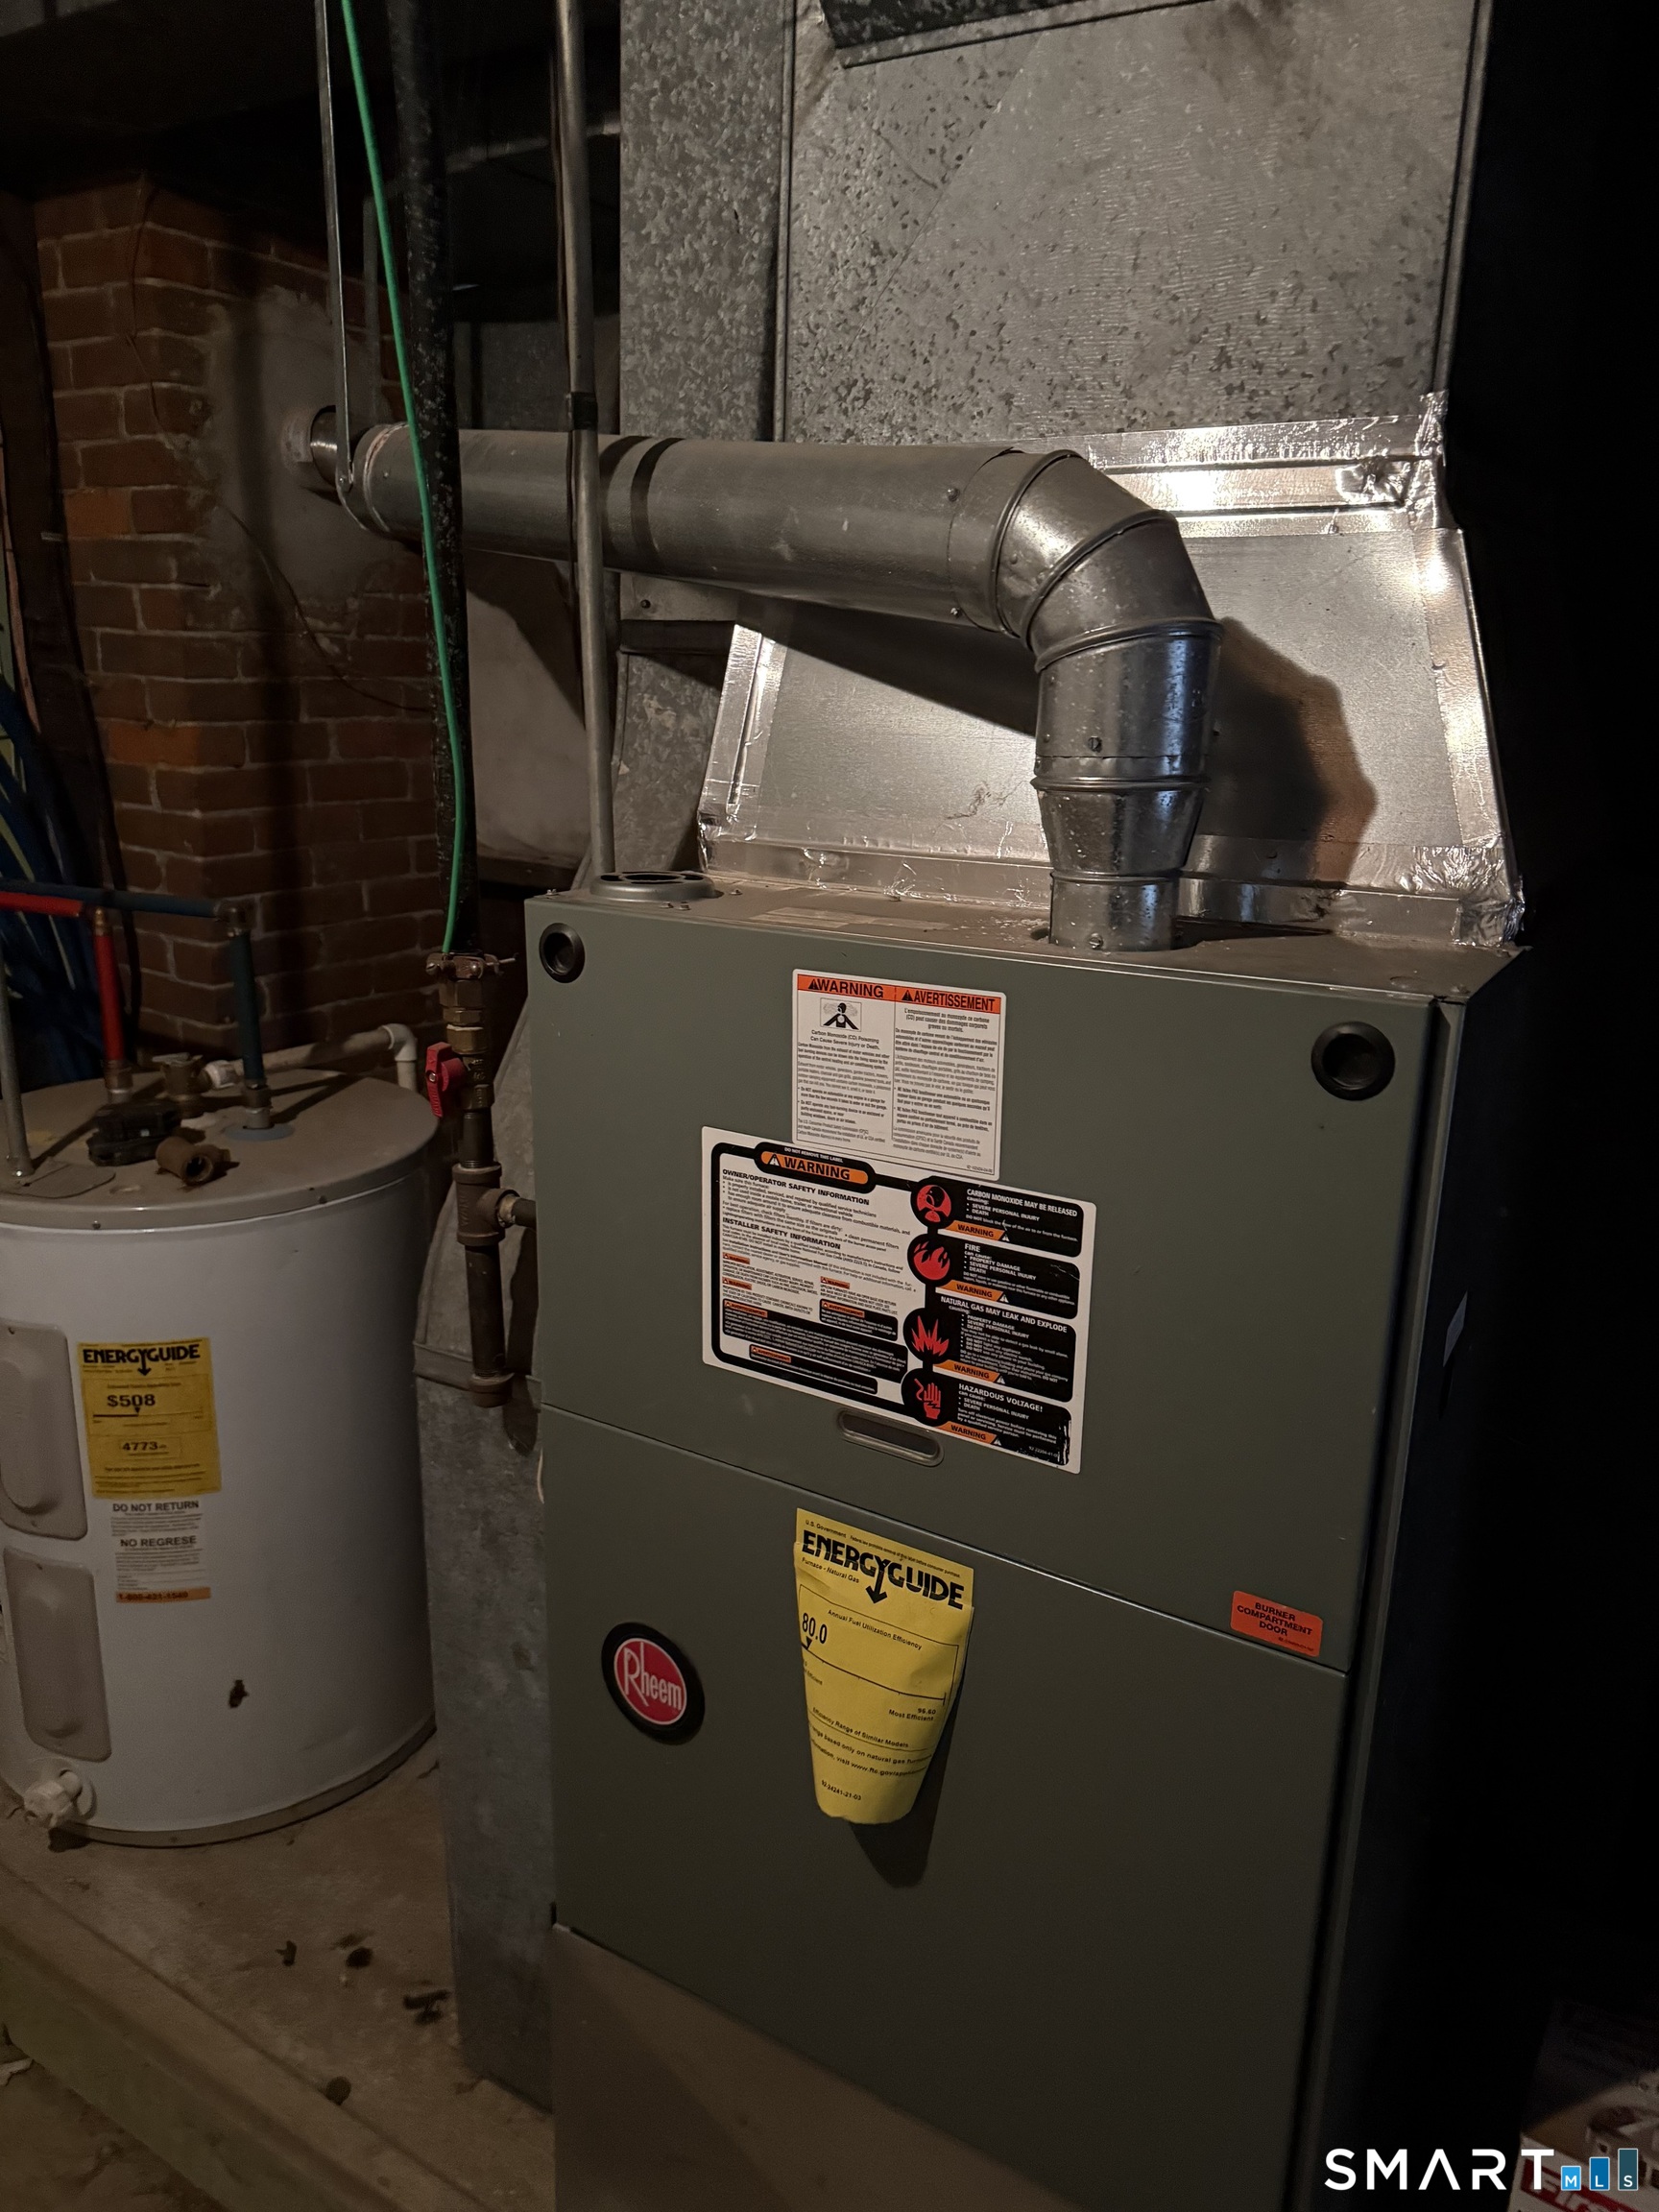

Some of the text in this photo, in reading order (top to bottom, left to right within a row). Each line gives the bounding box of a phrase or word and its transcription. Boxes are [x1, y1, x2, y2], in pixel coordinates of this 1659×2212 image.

[818, 979, 883, 998] WARNING
[914, 990, 995, 1011] AVERTISSEMENT
[784, 1157, 850, 1180] WARNING
[723, 1169, 869, 1205] OWNER/OPERATOR SAFETY INFORMATION
[967, 1189, 990, 1199] CARBON
[992, 1193, 1023, 1206] MONOXIDE
[1024, 1200, 1038, 1209] MAY
[1047, 1205, 1077, 1216] RELEASED
[972, 1203, 991, 1212] SEVERE
[993, 1208, 1020, 1217] PERSONAL
[723, 1216, 841, 1250] INSTALLER SAFETY INFORMATION
[958, 1224, 994, 1237] WARNING
[965, 1243, 980, 1252] FIRE
[970, 1257, 1021, 1271] PROPERTY DAMAGE
[989, 1266, 1017, 1276] PERSONAL
[956, 1284, 992, 1297] WARNING
[941, 1296, 970, 1309] NATURAL
[986, 1308, 1001, 1316] MAY
[1002, 1311, 1019, 1321] LEAK
[1021, 1316, 1035, 1325] AND
[1038, 1320, 1068, 1333] EXPLODE
[967, 1315, 1015, 1330] PROPERTY DAMAGE
[986, 1324, 1011, 1334] PERSONAL
[83, 1344, 201, 1366] ENERGYGUIDE
[954, 1364, 989, 1379] WARNING
[107, 1394, 156, 1407] $508
[959, 1383, 1043, 1412] HAZARDOUS VOLTAGE!
[969, 1393, 986, 1402] cause:
[964, 1398, 1029, 1420] SEVERE PERSONAL INJURY
[951, 1425, 986, 1440] WARNING
[122, 1441, 158, 1451] 4773
[112, 1501, 199, 1512] DO NOT RETURN
[816, 1524, 846, 1538] Government
[141, 1535, 196, 1547] REGRESE
[801, 1529, 965, 1611] ENERGYGUIDE
[803, 1557, 822, 1570] Furnace
[827, 1567, 847, 1578] Natural
[1237, 1605, 1312, 1635] COMPARTMENT
[1255, 1602, 1296, 1622] BURNER
[802, 1612, 828, 1645] 80.0
[828, 1609, 923, 1650] Annual Fuel Utilization Efficiency
[1259, 1621, 1287, 1636] DOOR
[624, 1642, 682, 1711] Rheem
[889, 1709, 905, 1718] Most
[835, 1721, 853, 1733] Range
[862, 1732, 884, 1743] Similar
[885, 1739, 908, 1747] Models
[824, 1735, 840, 1746] based
[842, 1743, 854, 1754] only
[867, 1753, 891, 1763] natural
[836, 1757, 850, 1766] visit
